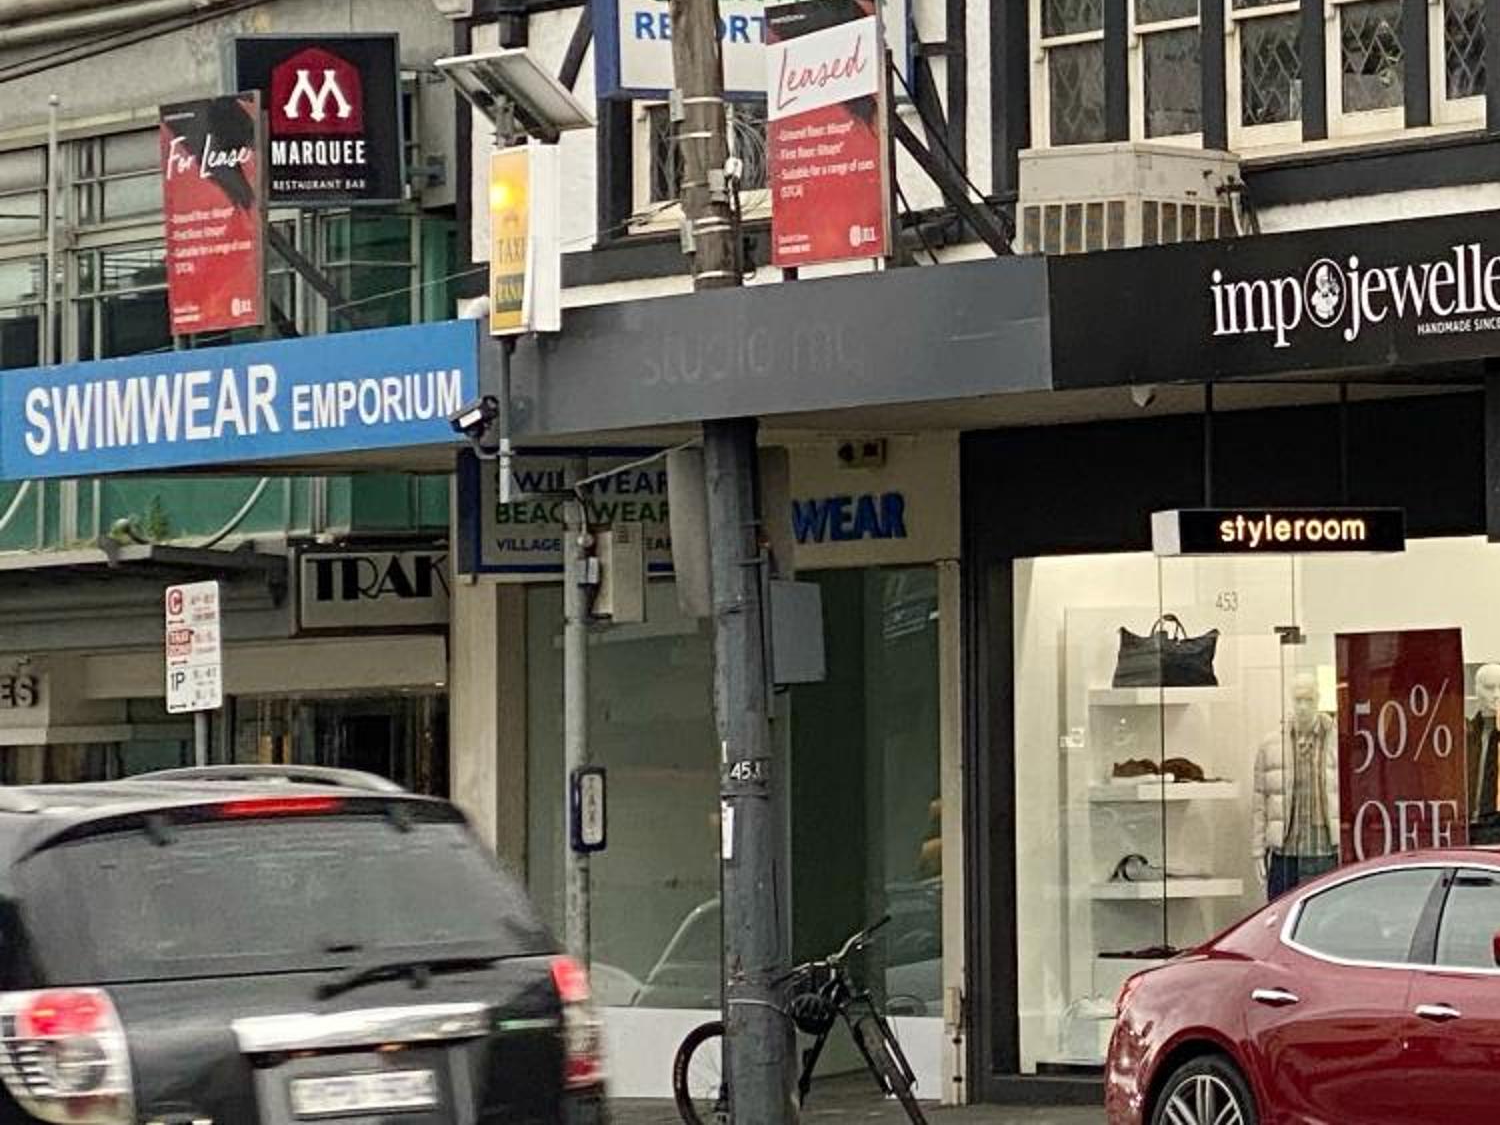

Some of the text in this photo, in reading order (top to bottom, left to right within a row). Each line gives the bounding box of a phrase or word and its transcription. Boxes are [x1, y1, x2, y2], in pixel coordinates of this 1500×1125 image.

[777, 35, 867, 111] Leased
[167, 134, 251, 179] For Lease
[271, 140, 366, 165] MARQUEE
[273, 179, 366, 191] RESTAURANT BAR
[1210, 268, 1303, 348] imp
[1417, 319, 1472, 335] HANDMADE
[24, 363, 465, 457] SWIMWEAR EMPORIUM
[792, 491, 908, 544] WEAR
[1220, 514, 1366, 547] styleroom
[1215, 590, 1239, 612] 453
[170, 672, 185, 691] 1P
[1354, 678, 1453, 773] 50%
[1353, 800, 1458, 861] OFF
